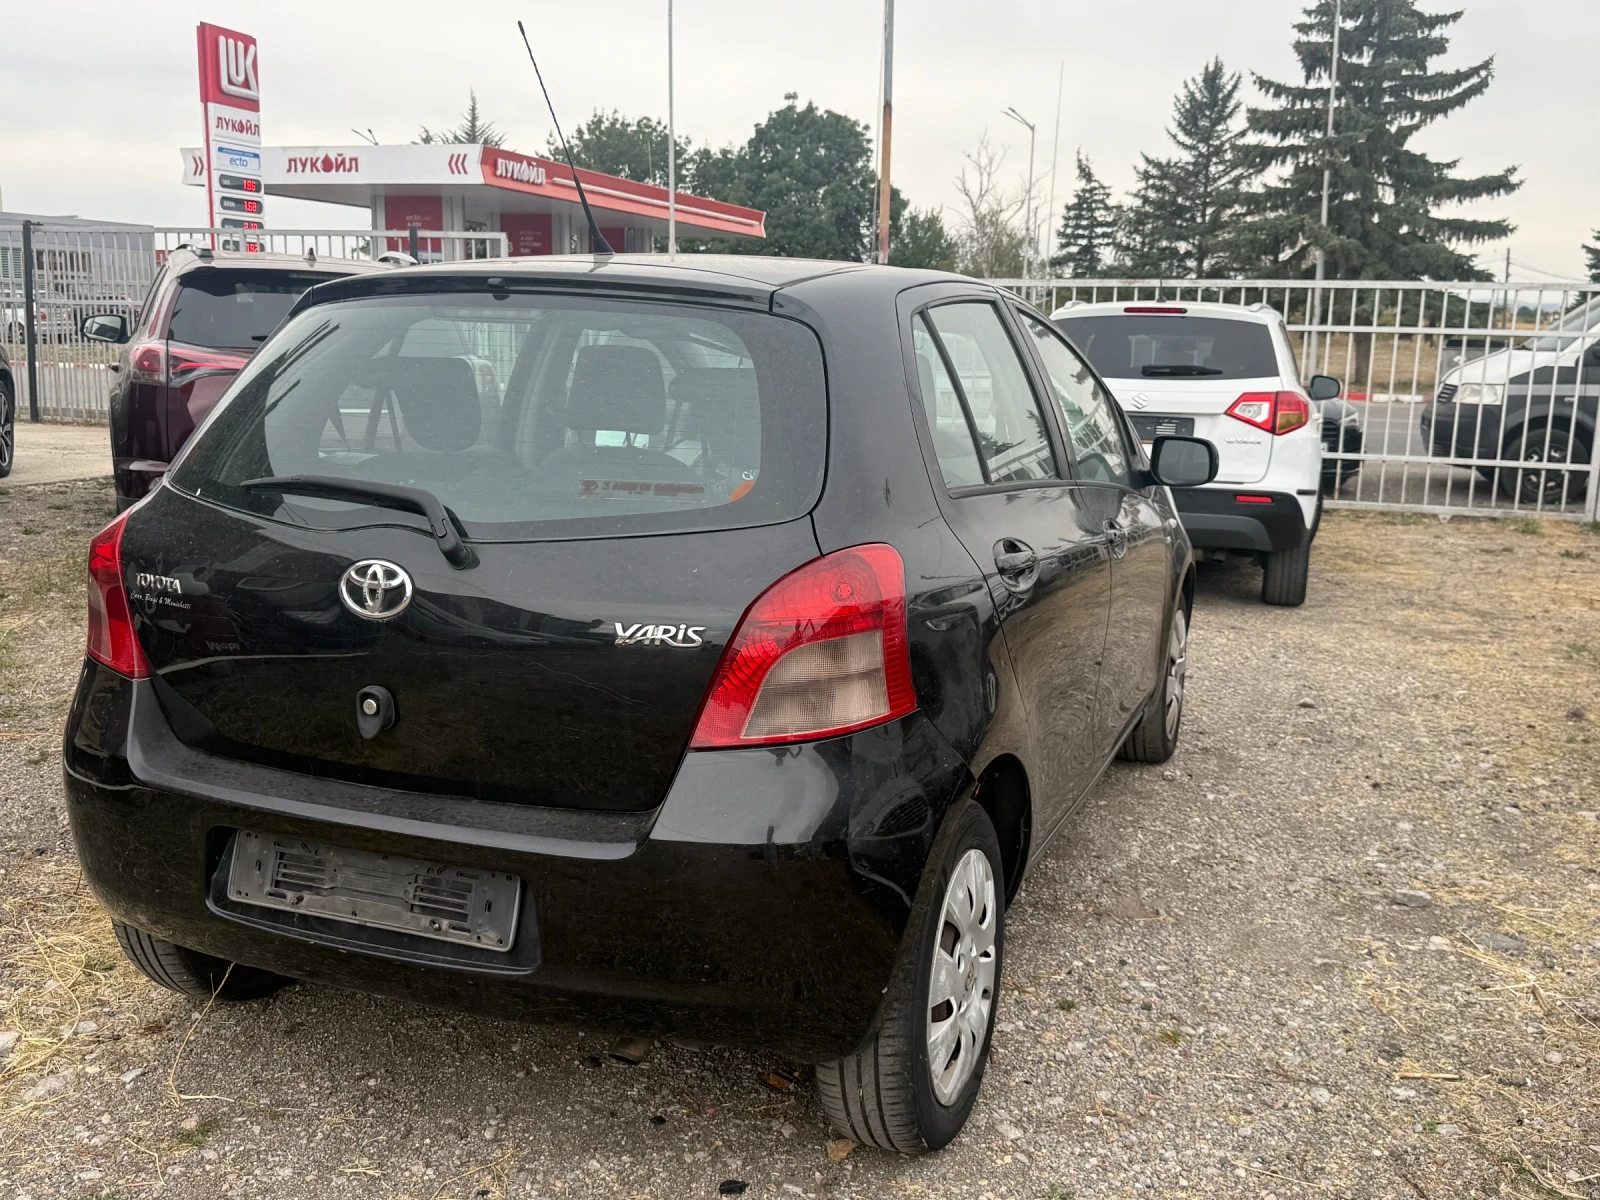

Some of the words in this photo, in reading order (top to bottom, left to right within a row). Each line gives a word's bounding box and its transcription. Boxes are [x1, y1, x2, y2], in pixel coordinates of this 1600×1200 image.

[229, 156, 248, 167] ecto
[286, 152, 359, 173] ЛУКОЙЛ
[495, 157, 546, 185] ЛУКОЙЛ
[135, 573, 182, 594] TOYOTA
